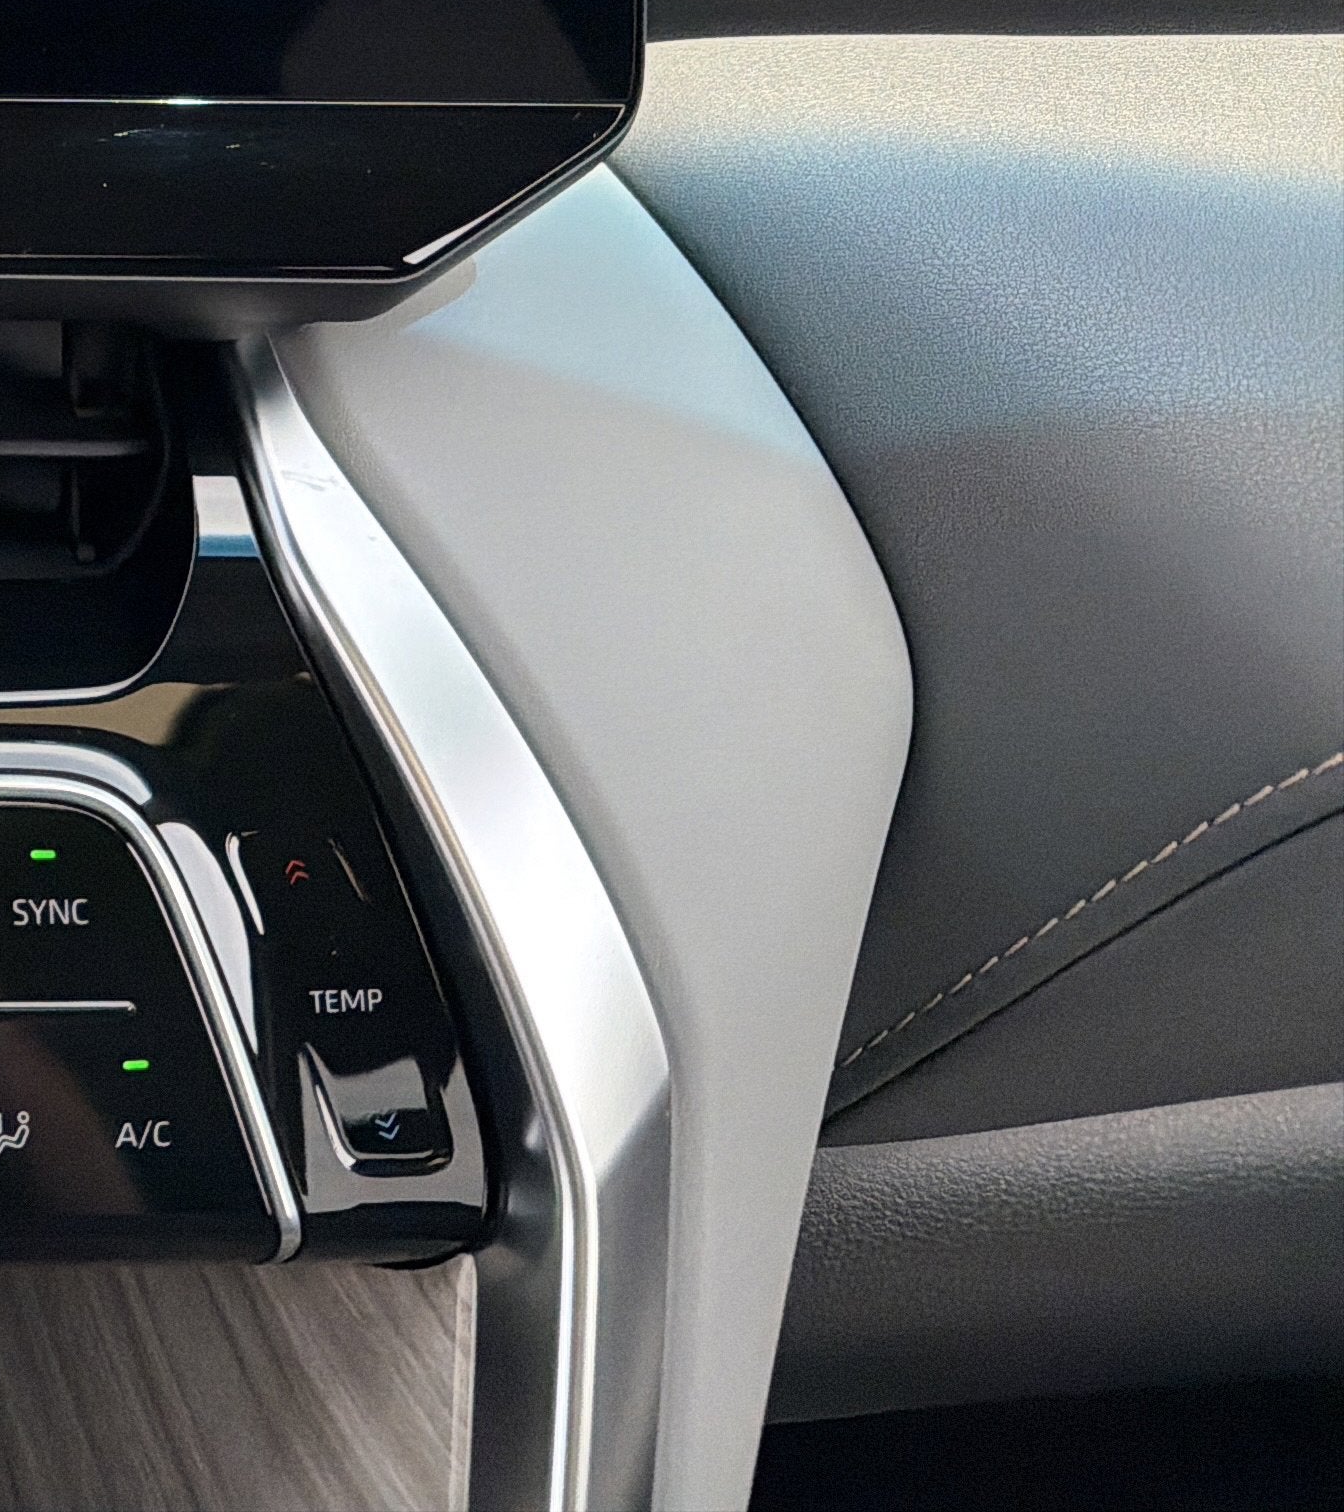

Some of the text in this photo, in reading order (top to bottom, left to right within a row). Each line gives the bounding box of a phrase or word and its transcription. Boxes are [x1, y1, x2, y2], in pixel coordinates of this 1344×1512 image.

[11, 897, 89, 927] SYNC
[310, 987, 383, 1015] TEMP
[115, 1119, 171, 1148] A/C
